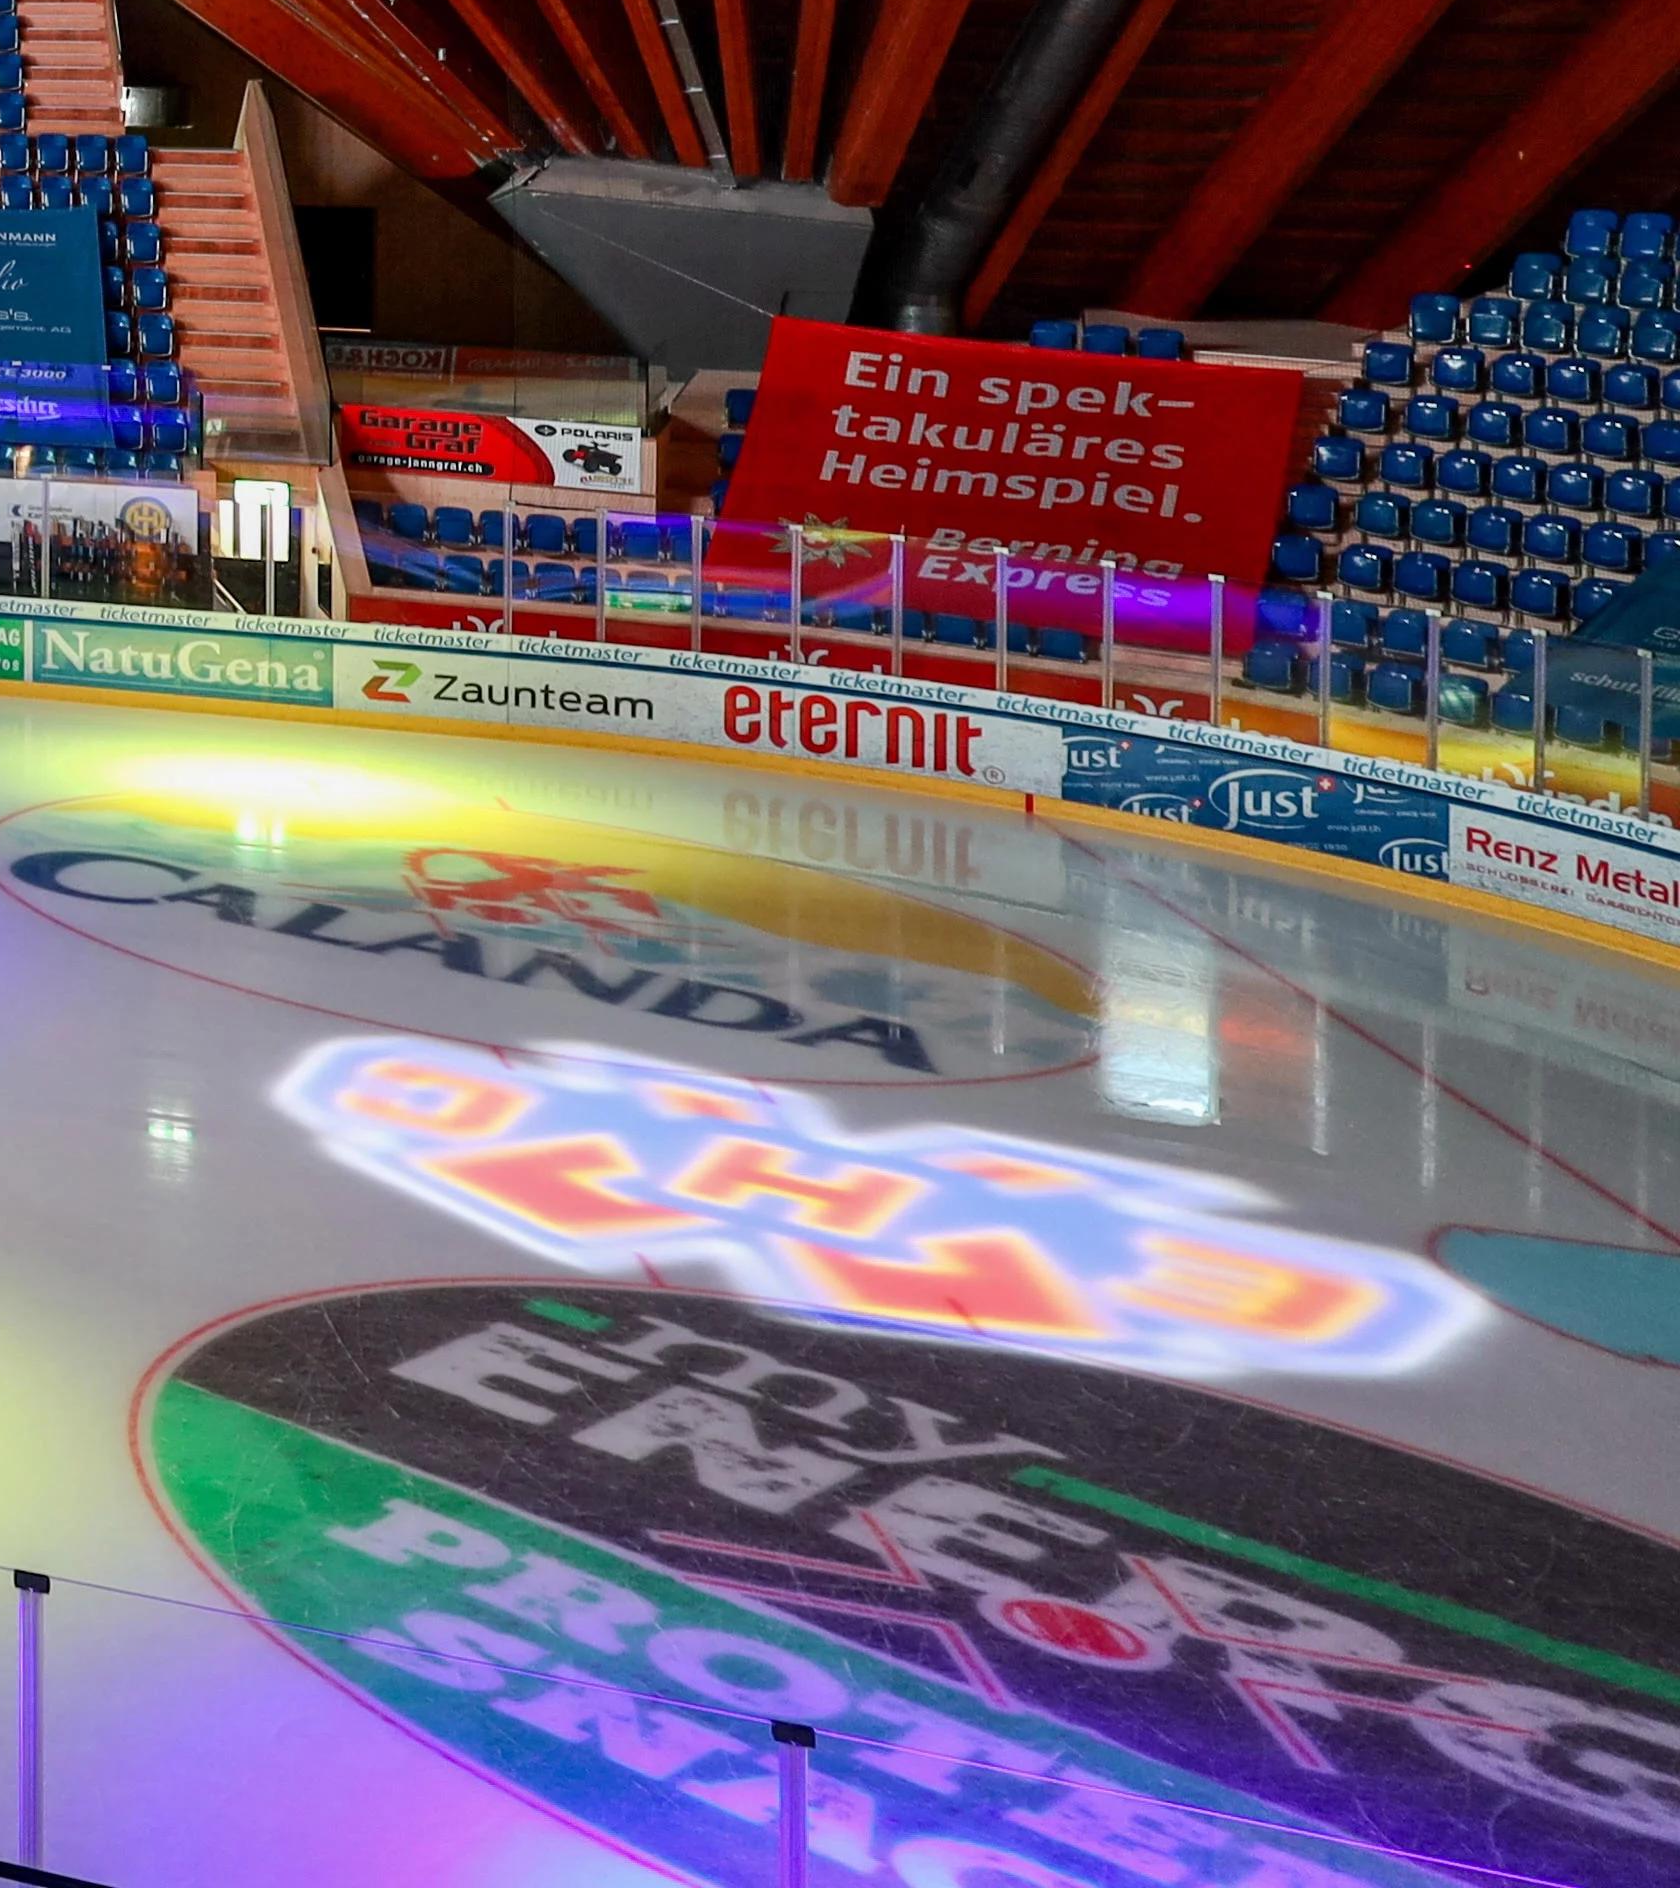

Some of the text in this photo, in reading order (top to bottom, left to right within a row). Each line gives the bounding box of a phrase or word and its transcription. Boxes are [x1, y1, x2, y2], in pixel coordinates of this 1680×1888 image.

[844, 350, 1195, 418] Ein spek-
[361, 411, 482, 435] Garage
[405, 433, 479, 454] Graf
[561, 428, 633, 441] POLARIS
[832, 404, 1185, 471] takuläres
[820, 450, 1202, 523] Heimspiel.
[925, 528, 1184, 581] Bernina
[918, 556, 1169, 607] Express
[234, 617, 350, 640] ticketmaster
[373, 626, 493, 651] ticketmaster
[41, 628, 323, 693] NatuGena
[669, 652, 802, 682] ticketmaster
[434, 674, 655, 721] Zaunteam
[828, 670, 968, 705] ticketmaster
[723, 685, 983, 776] eternit
[996, 693, 1138, 732] ticketmaster
[1223, 780, 1319, 830] Just
[1466, 827, 1559, 875] Renz
[7, 849, 942, 1073] CALANDA
